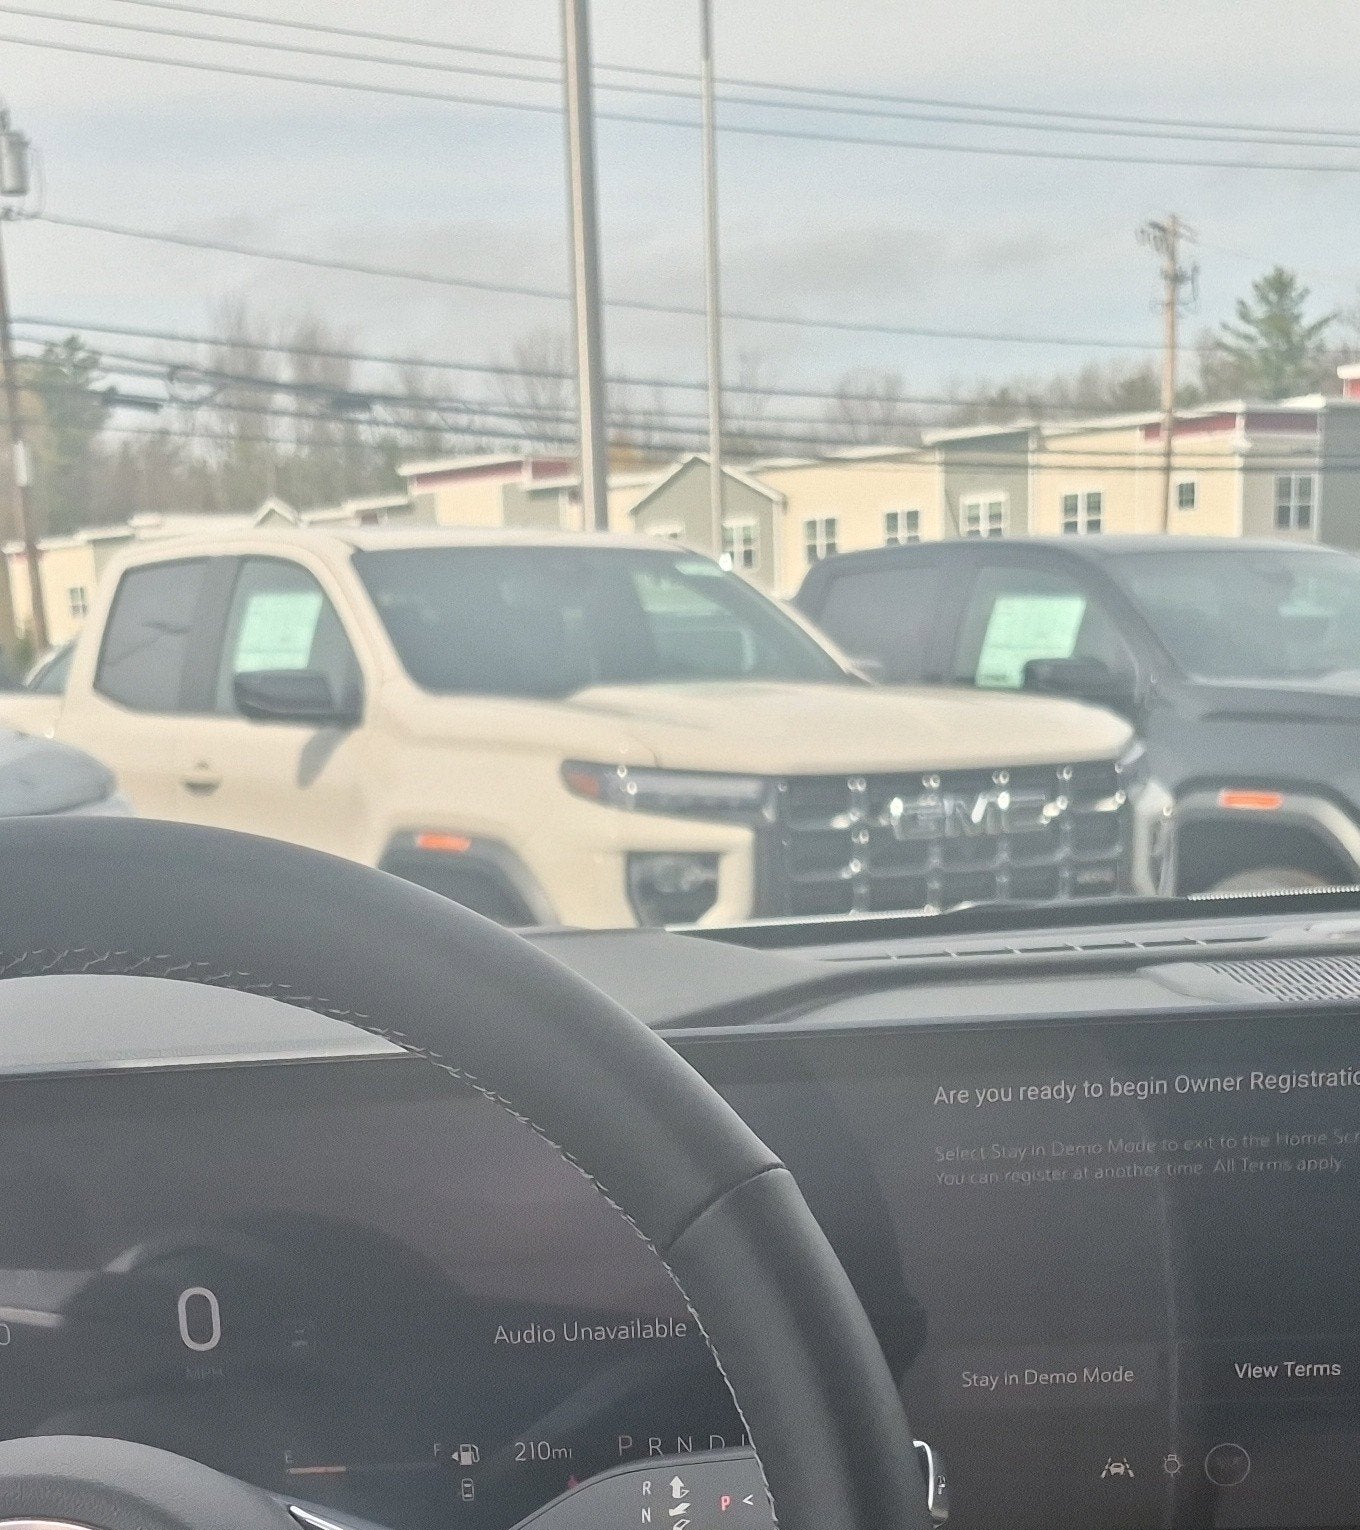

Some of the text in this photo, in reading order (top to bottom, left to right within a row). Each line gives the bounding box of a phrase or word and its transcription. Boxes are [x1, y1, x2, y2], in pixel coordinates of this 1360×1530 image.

[933, 1086, 969, 1105] Are
[975, 1086, 1012, 1108] you
[1019, 1080, 1077, 1103] ready
[1083, 1080, 1103, 1098] to
[1109, 1076, 1167, 1100] begin
[1174, 1073, 1243, 1093] Owner
[934, 1146, 986, 1162] Select
[990, 1143, 1027, 1162] Stay
[1030, 1143, 1046, 1156] in
[1051, 1141, 1103, 1157] Demo
[1108, 1138, 1158, 1154] Mode
[1162, 1138, 1178, 1151] to
[1183, 1137, 1215, 1151] exit
[1220, 1135, 1237, 1149] to
[1242, 1133, 1271, 1148] the
[1276, 1130, 1328, 1146] Home
[935, 1171, 965, 1186] You
[970, 1170, 999, 1184] can
[1003, 1167, 1067, 1186] register
[1072, 1167, 1089, 1181] at
[1094, 1163, 1160, 1179] another
[1213, 1157, 1236, 1173] All
[1240, 1157, 1291, 1173] Terms
[177, 1286, 221, 1352] 0
[494, 1317, 688, 1345] Audio Unavailable
[961, 1366, 1135, 1391] Stay in Demo Mode
[1234, 1360, 1342, 1379] View Terms
[618, 1435, 633, 1456] P
[648, 1437, 664, 1456] R
[677, 1436, 692, 1453] N
[642, 1480, 652, 1496] R
[641, 1507, 651, 1524] N
[720, 1495, 732, 1511] P
